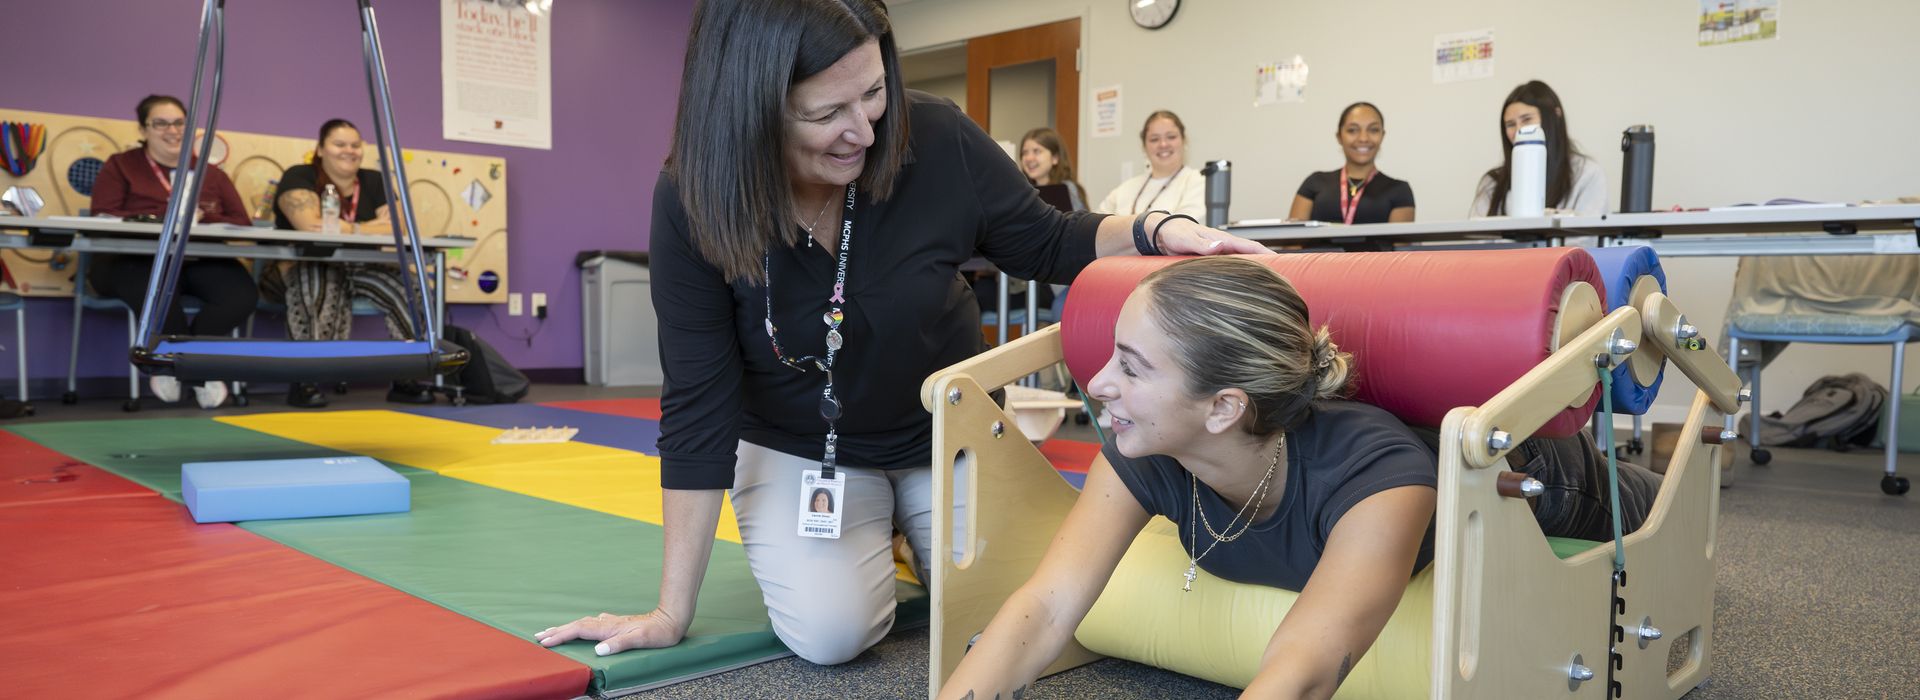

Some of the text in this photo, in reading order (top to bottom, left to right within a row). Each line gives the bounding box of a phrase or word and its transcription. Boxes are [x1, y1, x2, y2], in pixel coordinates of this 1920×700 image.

[846, 182, 857, 210] ERSITY
[836, 220, 852, 292] MCPHS UNIVERS
